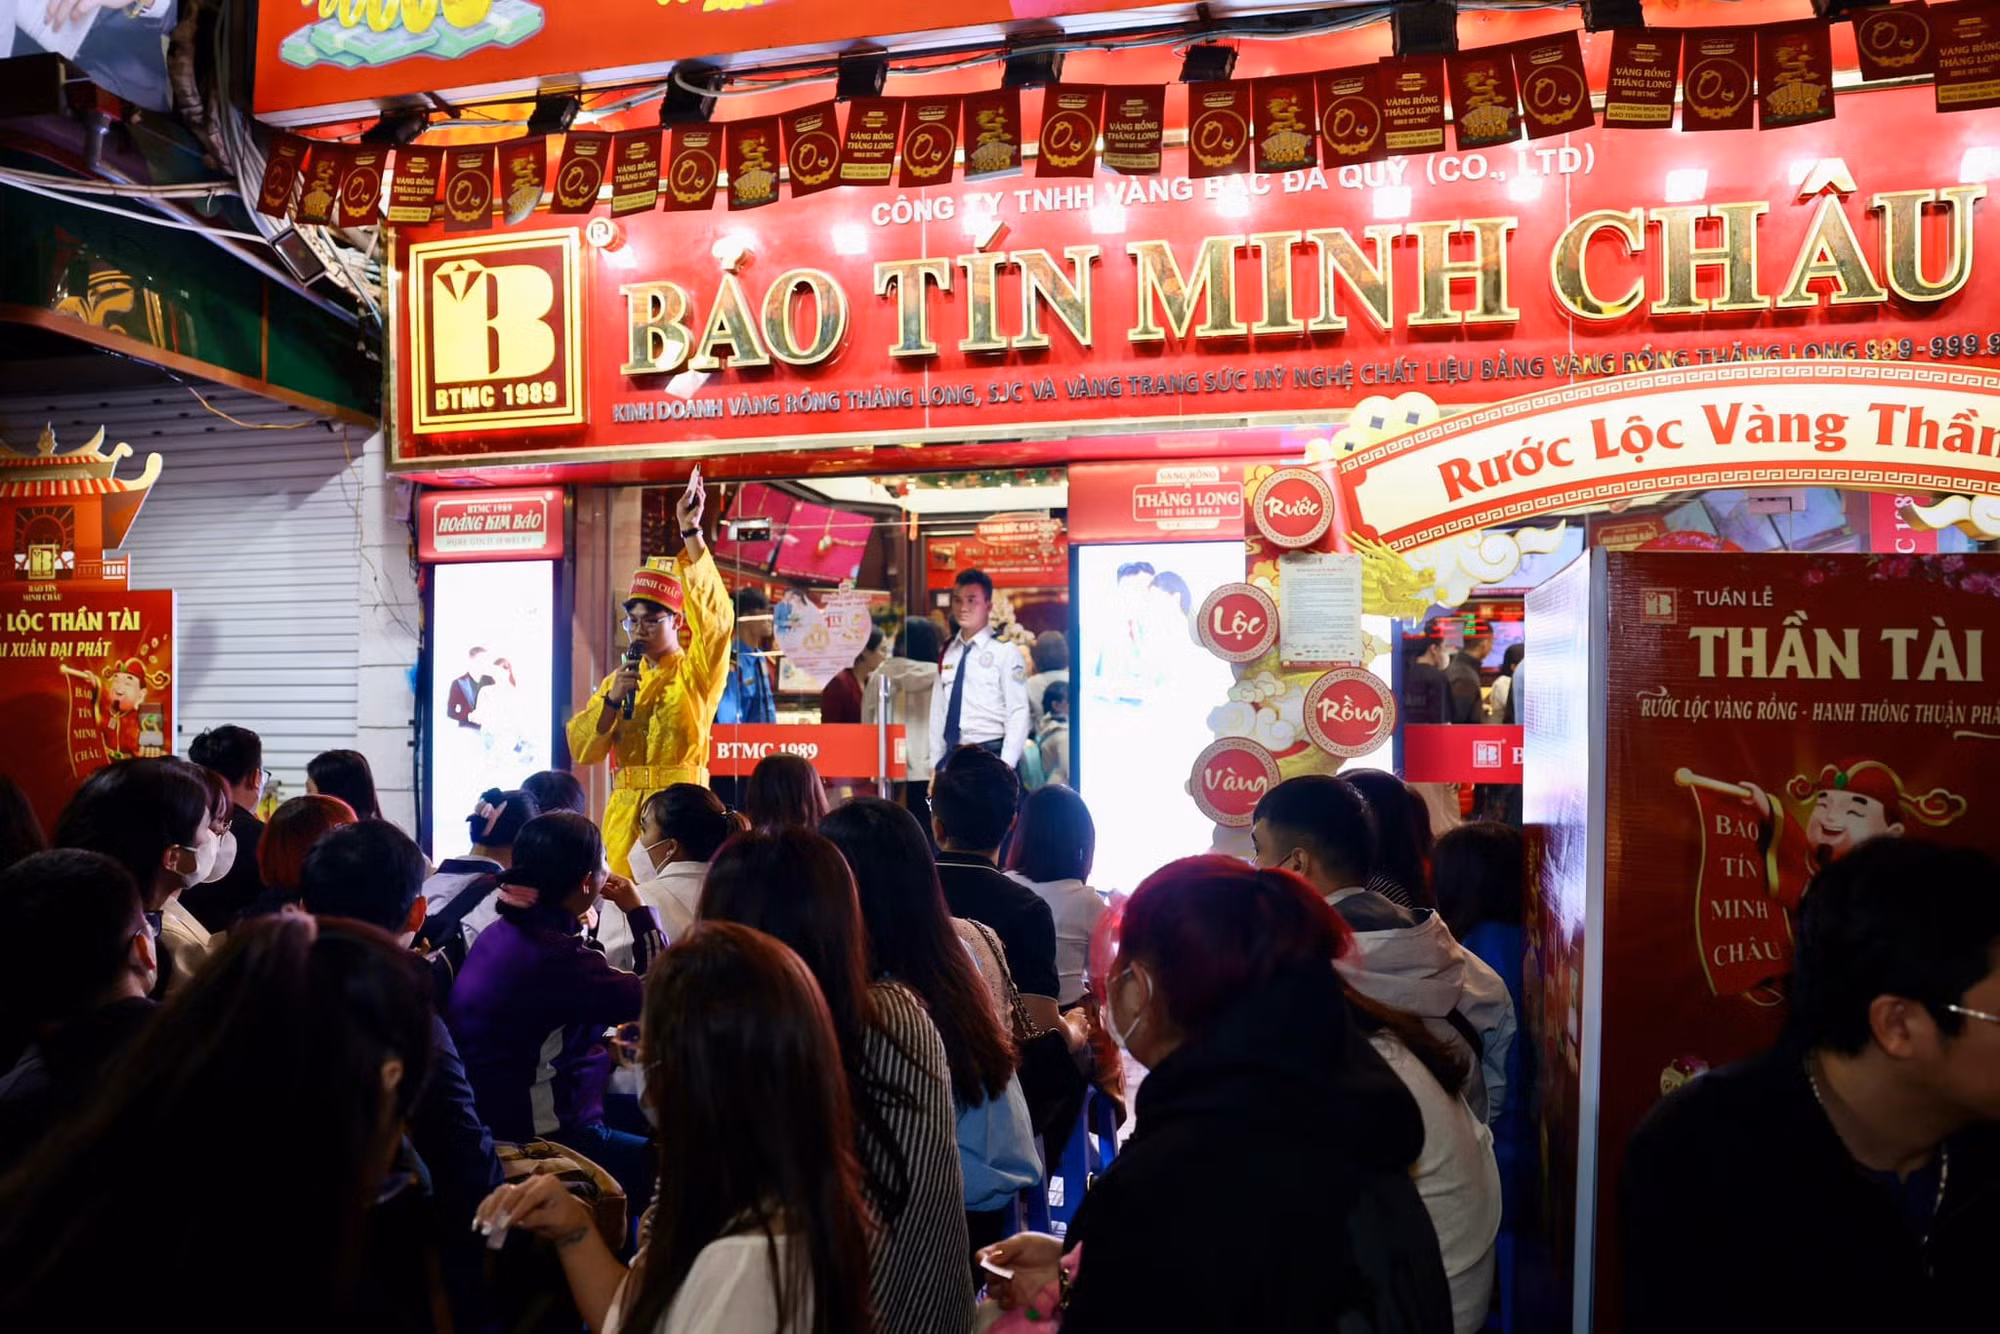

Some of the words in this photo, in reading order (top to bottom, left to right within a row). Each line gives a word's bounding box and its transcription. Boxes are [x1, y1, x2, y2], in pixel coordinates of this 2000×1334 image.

[1977, 53, 2000, 63] LON
[871, 189, 955, 226] CÔNG
[963, 190, 1004, 217] TY
[1014, 183, 1095, 213] TNHH
[1105, 175, 1193, 206] VÀNG
[1517, 143, 1596, 177] LTD)
[619, 236, 848, 376] BẢO
[874, 219, 1101, 359] TÍN
[1127, 216, 1520, 342] MINH
[1550, 158, 1987, 320] CHÂU
[434, 385, 495, 411] BTMC
[502, 380, 557, 406] 1989
[612, 403, 655, 423] KINH
[657, 397, 723, 420] DOANH
[728, 390, 780, 416] VÀNG
[785, 387, 841, 413] RỒNG
[846, 384, 913, 410] THĂNG
[919, 384, 983, 409] LONG,
[988, 382, 1024, 403] SJC
[1030, 376, 1056, 401] VÀ
[1065, 374, 1122, 399] VÀNG
[1127, 372, 1199, 396] TRANG
[1203, 366, 1248, 391] SỨC
[1252, 366, 1287, 391] MỸ
[1293, 359, 1354, 391] NGHỆ
[1359, 355, 1419, 386] CHẤT
[1425, 354, 1474, 384] LIỆU
[1480, 347, 1546, 379] BẰNG
[1552, 350, 1616, 376] VÀNG
[1622, 342, 1690, 374] RỒNG
[1695, 341, 1782, 366] THĂNG
[1437, 436, 1572, 503] Rước
[1590, 416, 1686, 464] Lộc
[1701, 402, 1850, 453] Vàng
[1868, 402, 2000, 458] Thần
[1135, 490, 1193, 508] THĂNG
[1196, 491, 1240, 507] LONG
[1265, 496, 1321, 519] Rước
[438, 512, 485, 533] HOÀNG
[485, 514, 511, 531] KIM
[512, 509, 542, 530] BẢO
[6, 609, 45, 636] LỘC
[48, 605, 104, 632] THẦN
[107, 607, 141, 631] TÀI
[1213, 605, 1265, 640] Lộc
[10, 638, 47, 657] XUÂN
[50, 640, 73, 661] ĐẠI
[76, 637, 112, 657] PHÁT
[1688, 610, 1861, 680] THẦN
[1880, 616, 1985, 682] TÀI
[1317, 694, 1384, 736] Rồng
[1641, 694, 1680, 718] RƯỚC
[1684, 694, 1711, 724] LỘC
[1714, 695, 1753, 720] VÀNG
[1756, 691, 1798, 721] RỒNG
[1812, 702, 1856, 723] HANH
[1860, 699, 1910, 723] THÔNG
[1914, 700, 1967, 729] THUẬN
[717, 742, 774, 760] BTMC
[1204, 766, 1268, 806] Vàng
[1715, 813, 1760, 841] BẢO
[1720, 853, 1758, 879] TÍN
[1711, 900, 1769, 922] MINH
[1713, 936, 1783, 967] CHÂU
